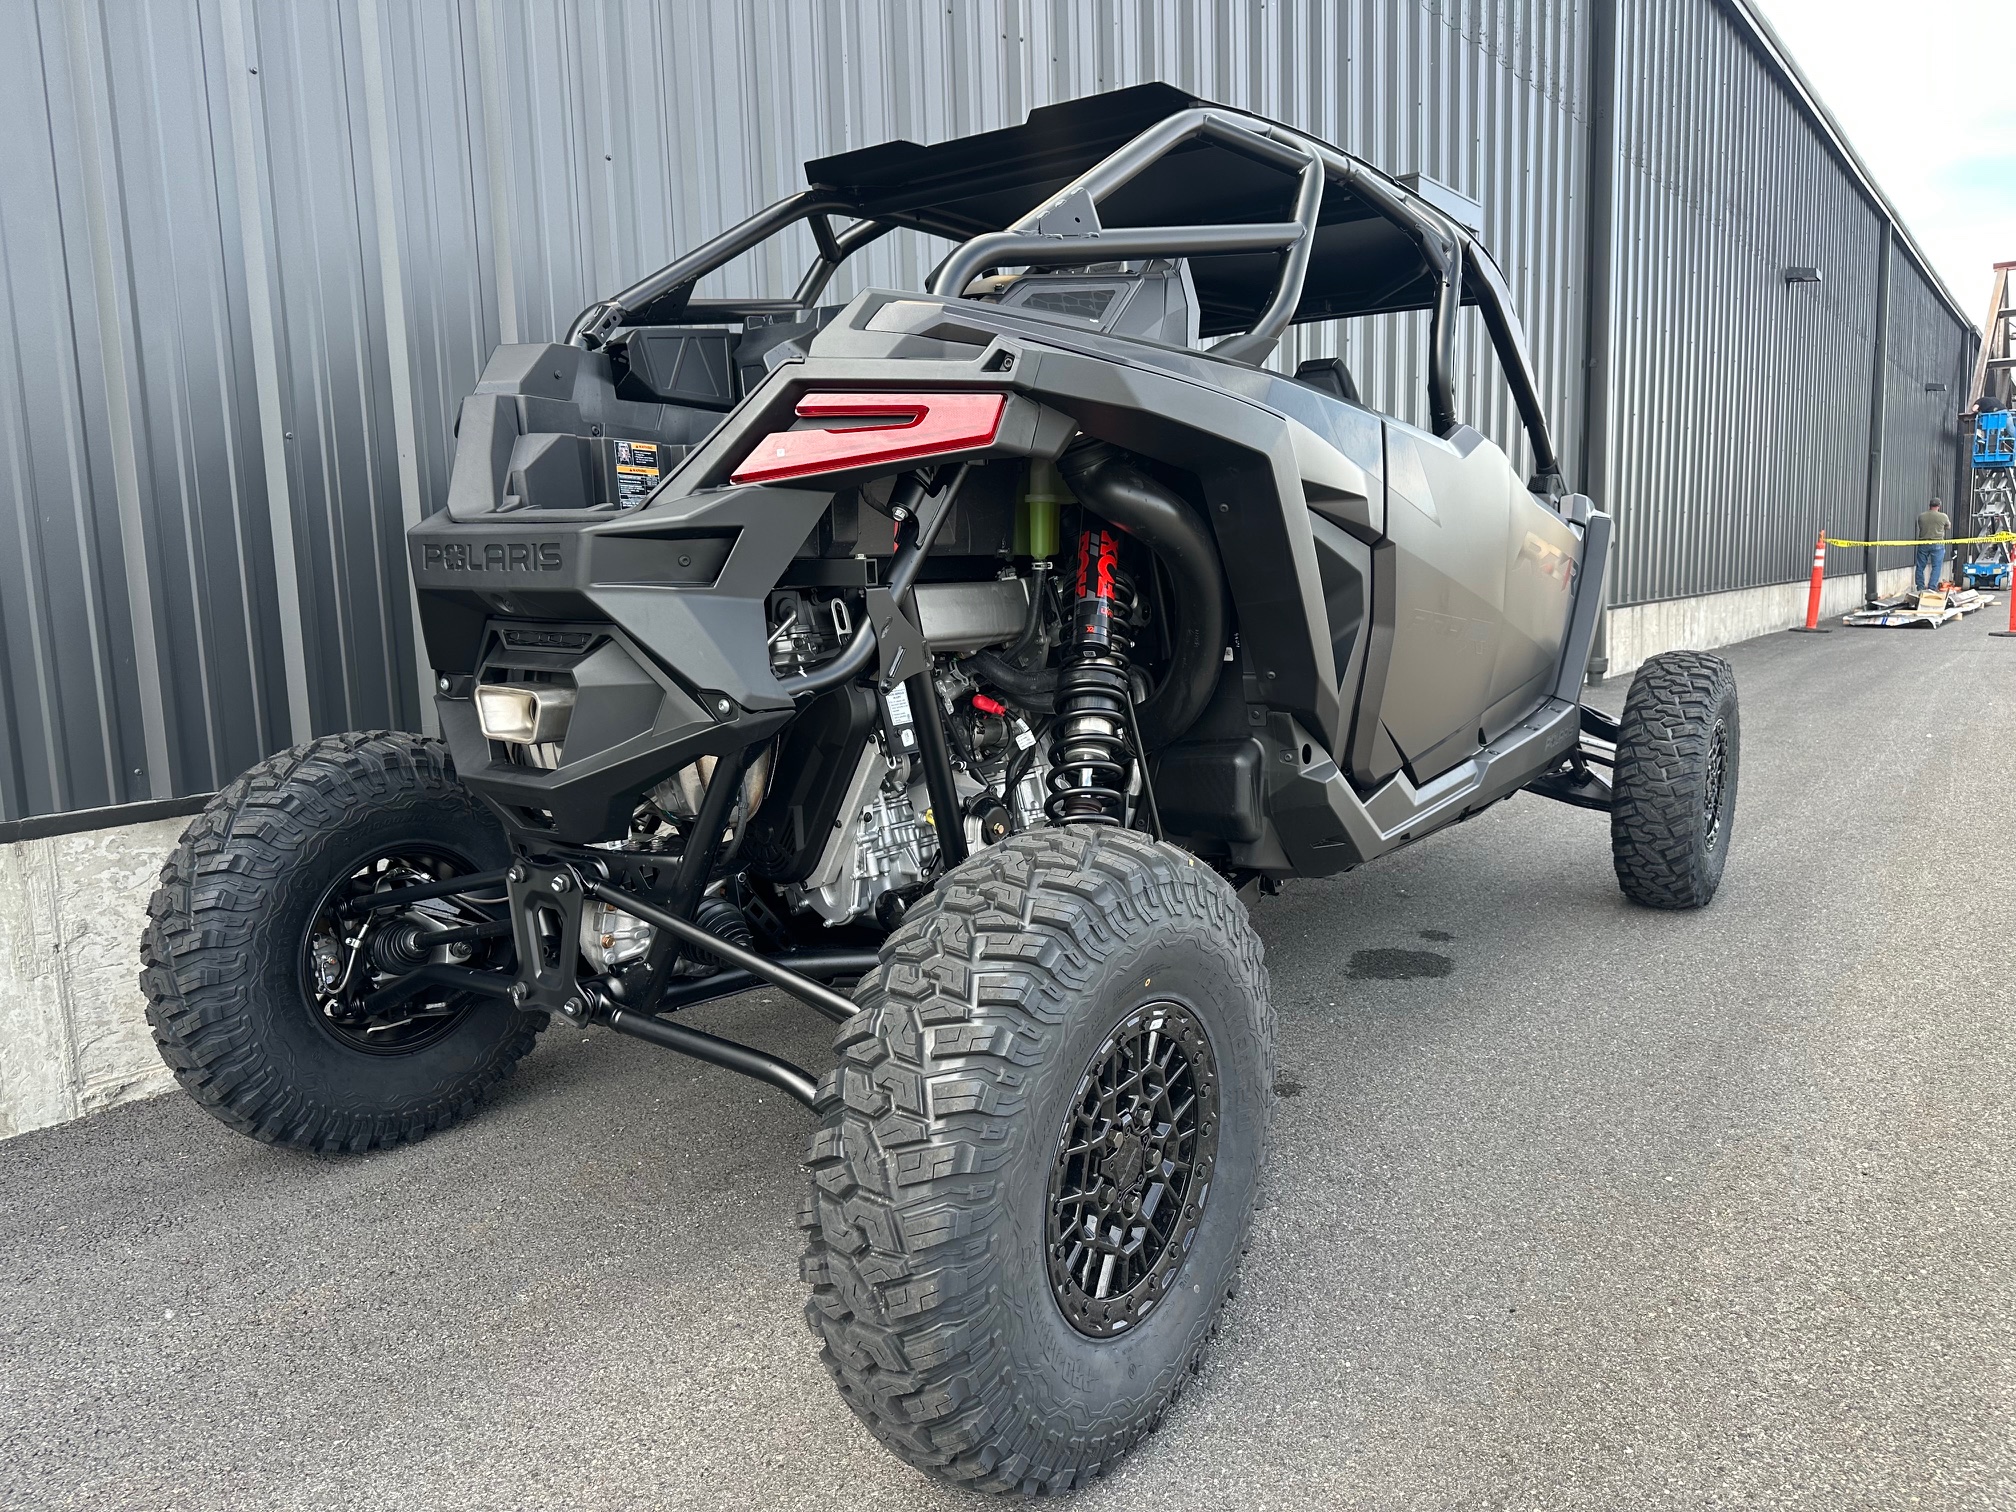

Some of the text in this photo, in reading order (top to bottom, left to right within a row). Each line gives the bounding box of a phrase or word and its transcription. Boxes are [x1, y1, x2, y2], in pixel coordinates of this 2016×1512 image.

[423, 542, 563, 572] POLARIS
[1097, 530, 1119, 601] FOX
[1544, 724, 1575, 752] POLARIS
